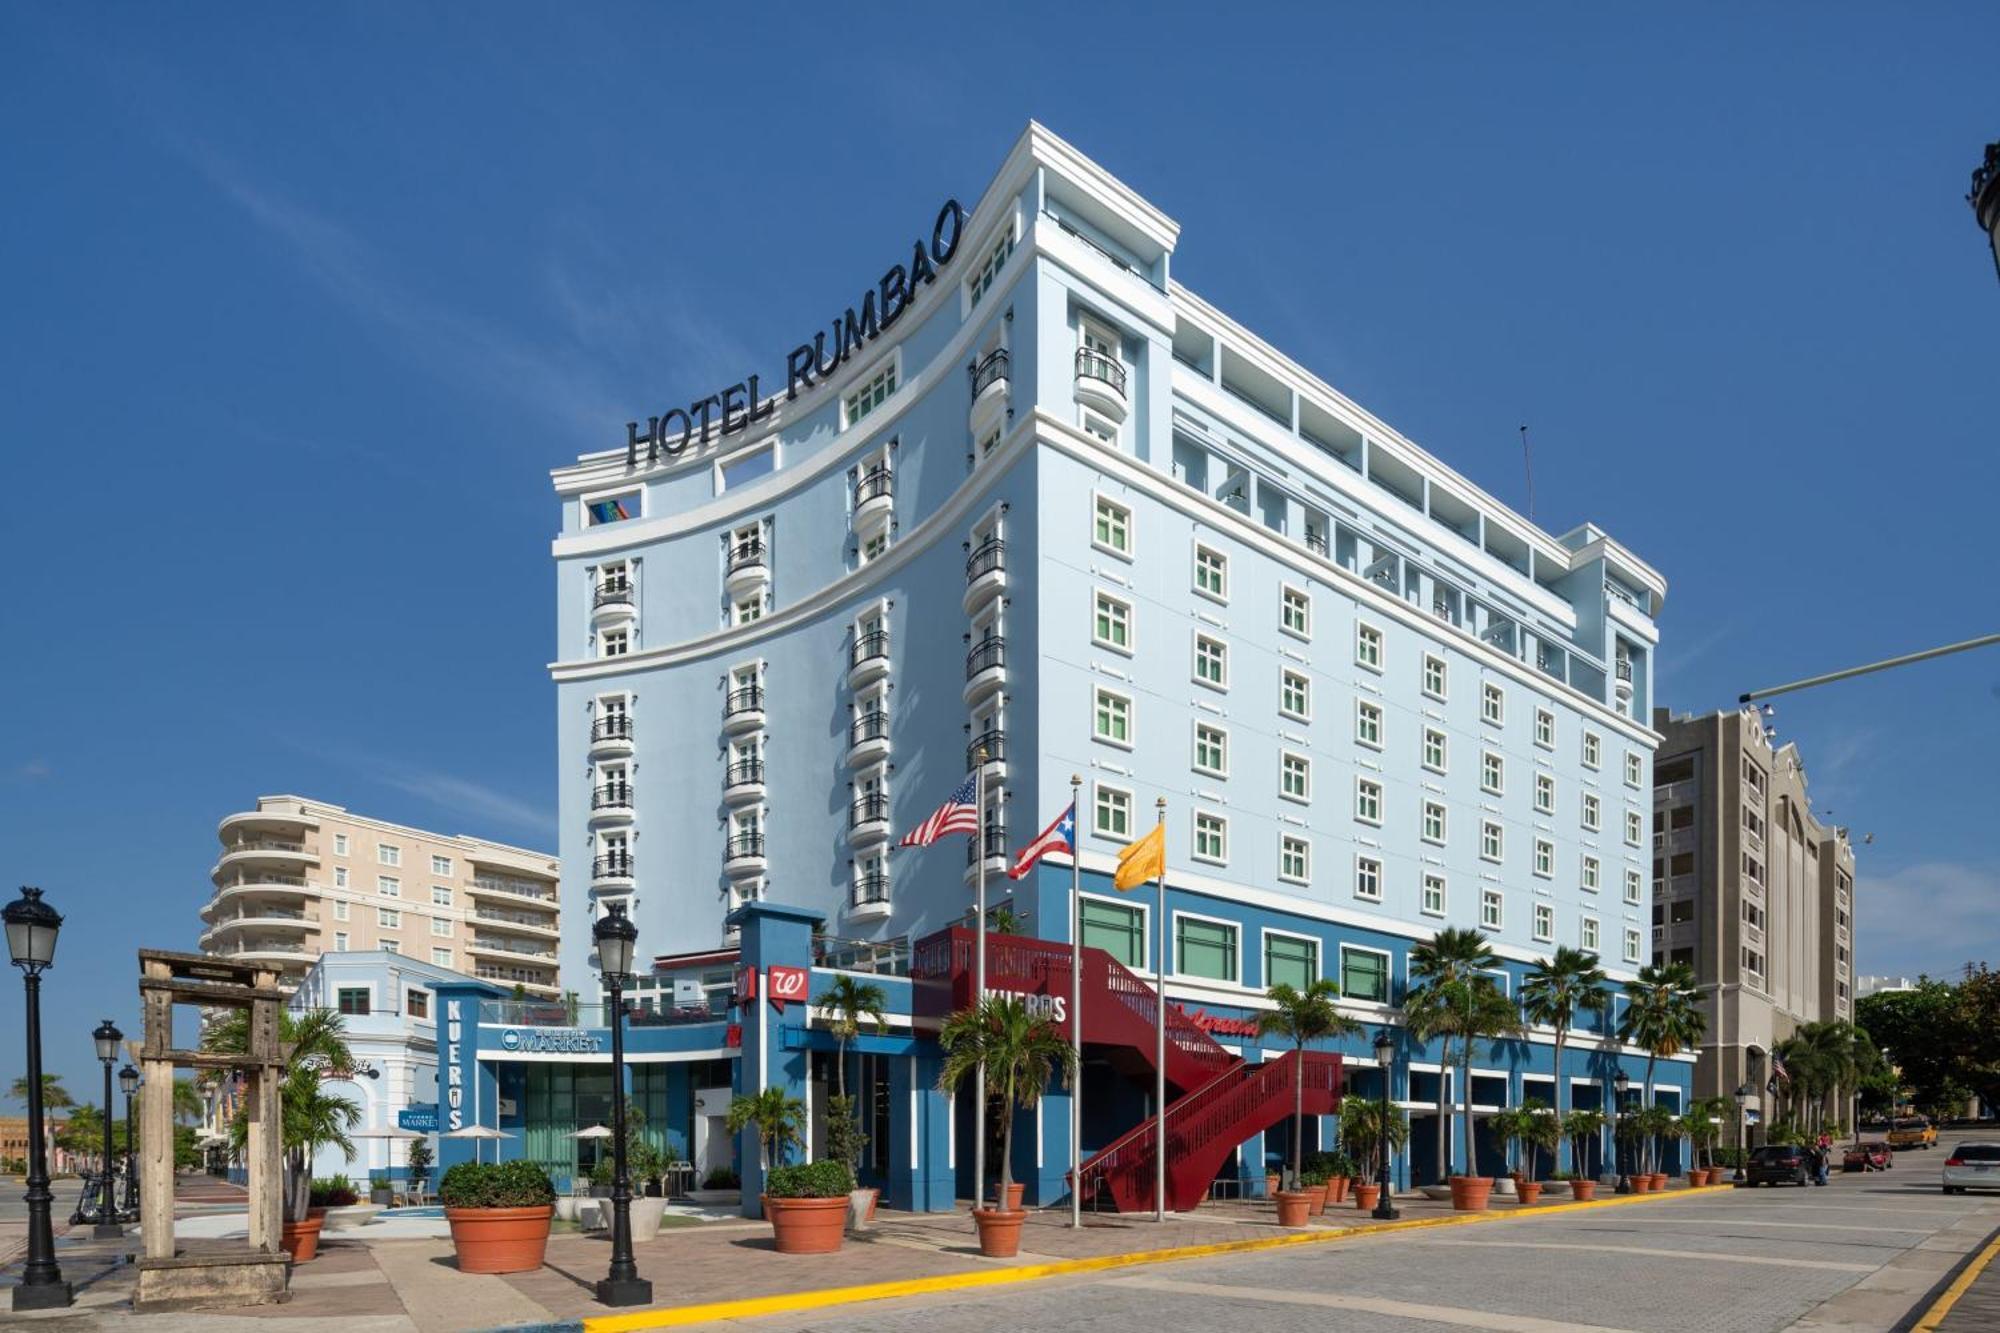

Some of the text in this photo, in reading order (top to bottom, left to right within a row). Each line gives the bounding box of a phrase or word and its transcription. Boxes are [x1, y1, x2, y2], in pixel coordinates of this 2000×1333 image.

[626, 199, 963, 465] HOTEL RUMBAO
[773, 972, 804, 994] W
[520, 1035, 602, 1053] MARKET
[448, 1000, 462, 1130] KUEROS
[402, 1119, 438, 1129] MARKET
